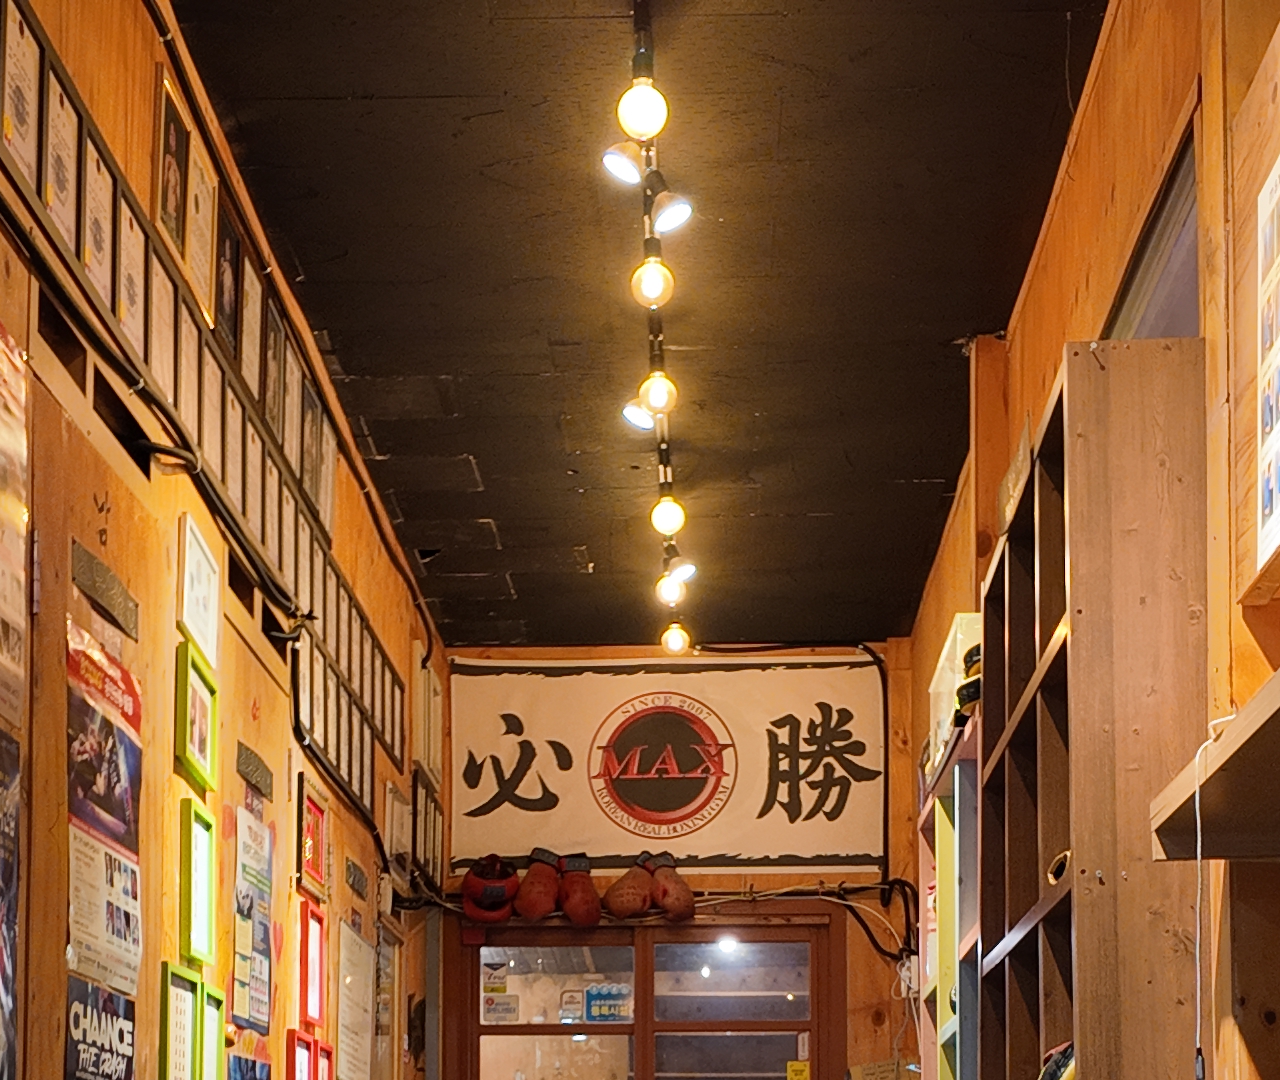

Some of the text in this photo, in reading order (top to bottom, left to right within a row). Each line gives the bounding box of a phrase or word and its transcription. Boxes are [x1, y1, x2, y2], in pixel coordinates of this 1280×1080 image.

[621, 695, 712, 721] SINCE 2007
[462, 712, 574, 818] 必
[591, 743, 735, 780] MAX
[757, 701, 883, 823] 勝
[596, 784, 730, 836] KOREAN REAL BOXING GYM
[69, 999, 134, 1057] CHAANCE
[76, 1043, 101, 1074] THE
